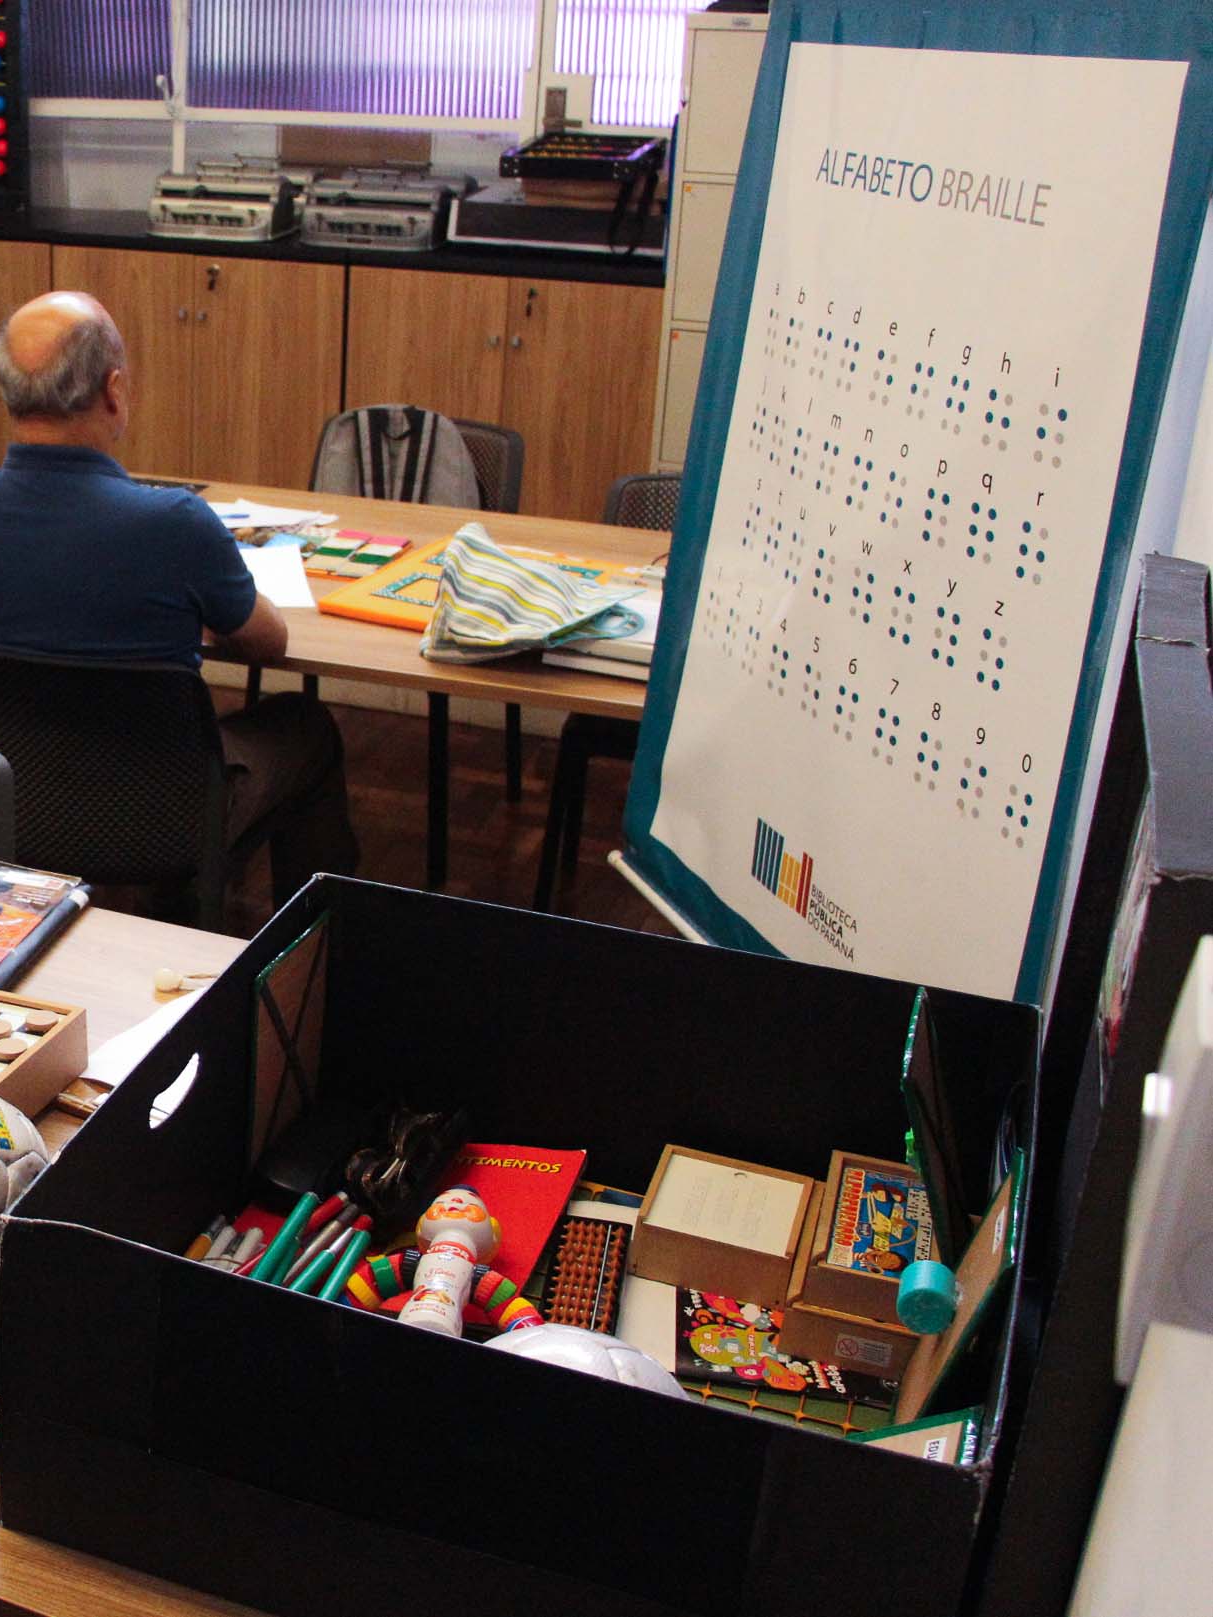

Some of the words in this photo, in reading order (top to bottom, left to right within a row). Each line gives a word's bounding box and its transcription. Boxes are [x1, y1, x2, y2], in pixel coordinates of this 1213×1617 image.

[816, 148, 933, 202] ALFABETO
[938, 168, 1052, 227] BRAILLE
[797, 287, 806, 305] b
[827, 301, 835, 315] c
[852, 306, 862, 325] d
[889, 321, 898, 337] e
[927, 327, 936, 347] f
[961, 345, 972, 366] g
[1000, 351, 1011, 375] h
[1054, 367, 1060, 388] i
[830, 413, 842, 429] m
[864, 428, 874, 444] n
[900, 443, 909, 458] o
[936, 459, 948, 478] p
[981, 473, 993, 495] q
[1036, 491, 1045, 507] r
[756, 478, 763, 491] s
[799, 506, 807, 521] u
[829, 522, 837, 537] v
[862, 540, 873, 556] w
[903, 559, 912, 576] x
[946, 578, 958, 598] y
[994, 600, 1005, 617] z
[779, 618, 787, 633] 4
[812, 636, 820, 654] 5
[848, 658, 858, 675] 6
[890, 678, 900, 696] 7
[931, 702, 942, 721] 8
[975, 727, 986, 745] 9
[1021, 753, 1032, 774] 0
[807, 912, 820, 931] DO
[810, 884, 857, 934] BIBLIOTECA
